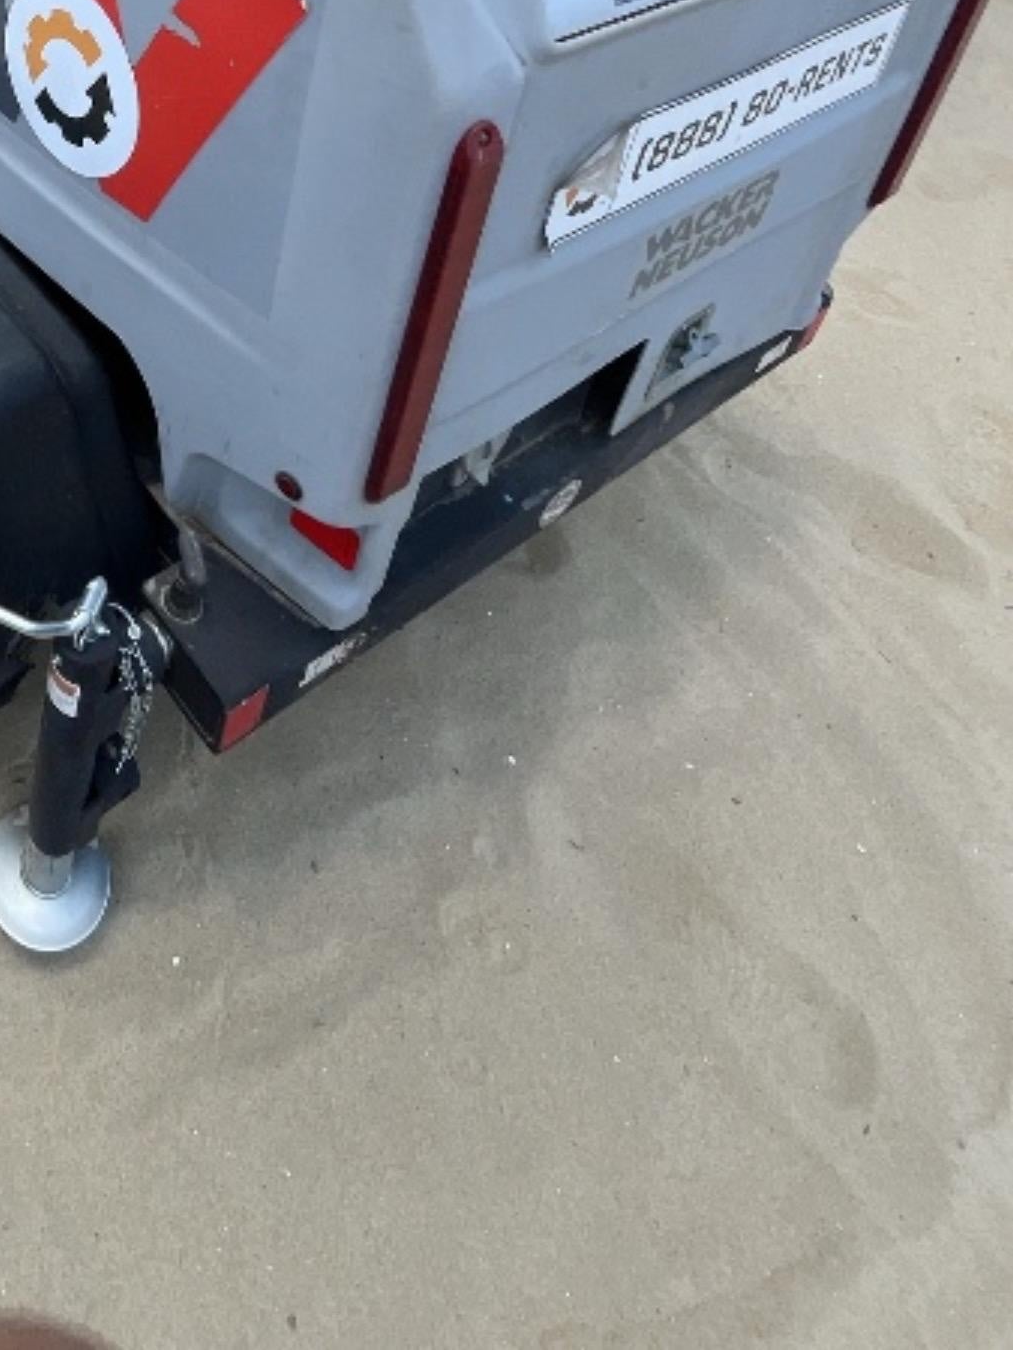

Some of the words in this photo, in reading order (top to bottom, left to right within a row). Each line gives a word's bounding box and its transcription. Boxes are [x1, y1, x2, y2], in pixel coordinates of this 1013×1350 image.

[632, 101, 738, 181] (888)
[741, 33, 888, 127] 80-RENTS
[628, 198, 771, 300] NEUSON
[646, 168, 780, 262] WACKER
